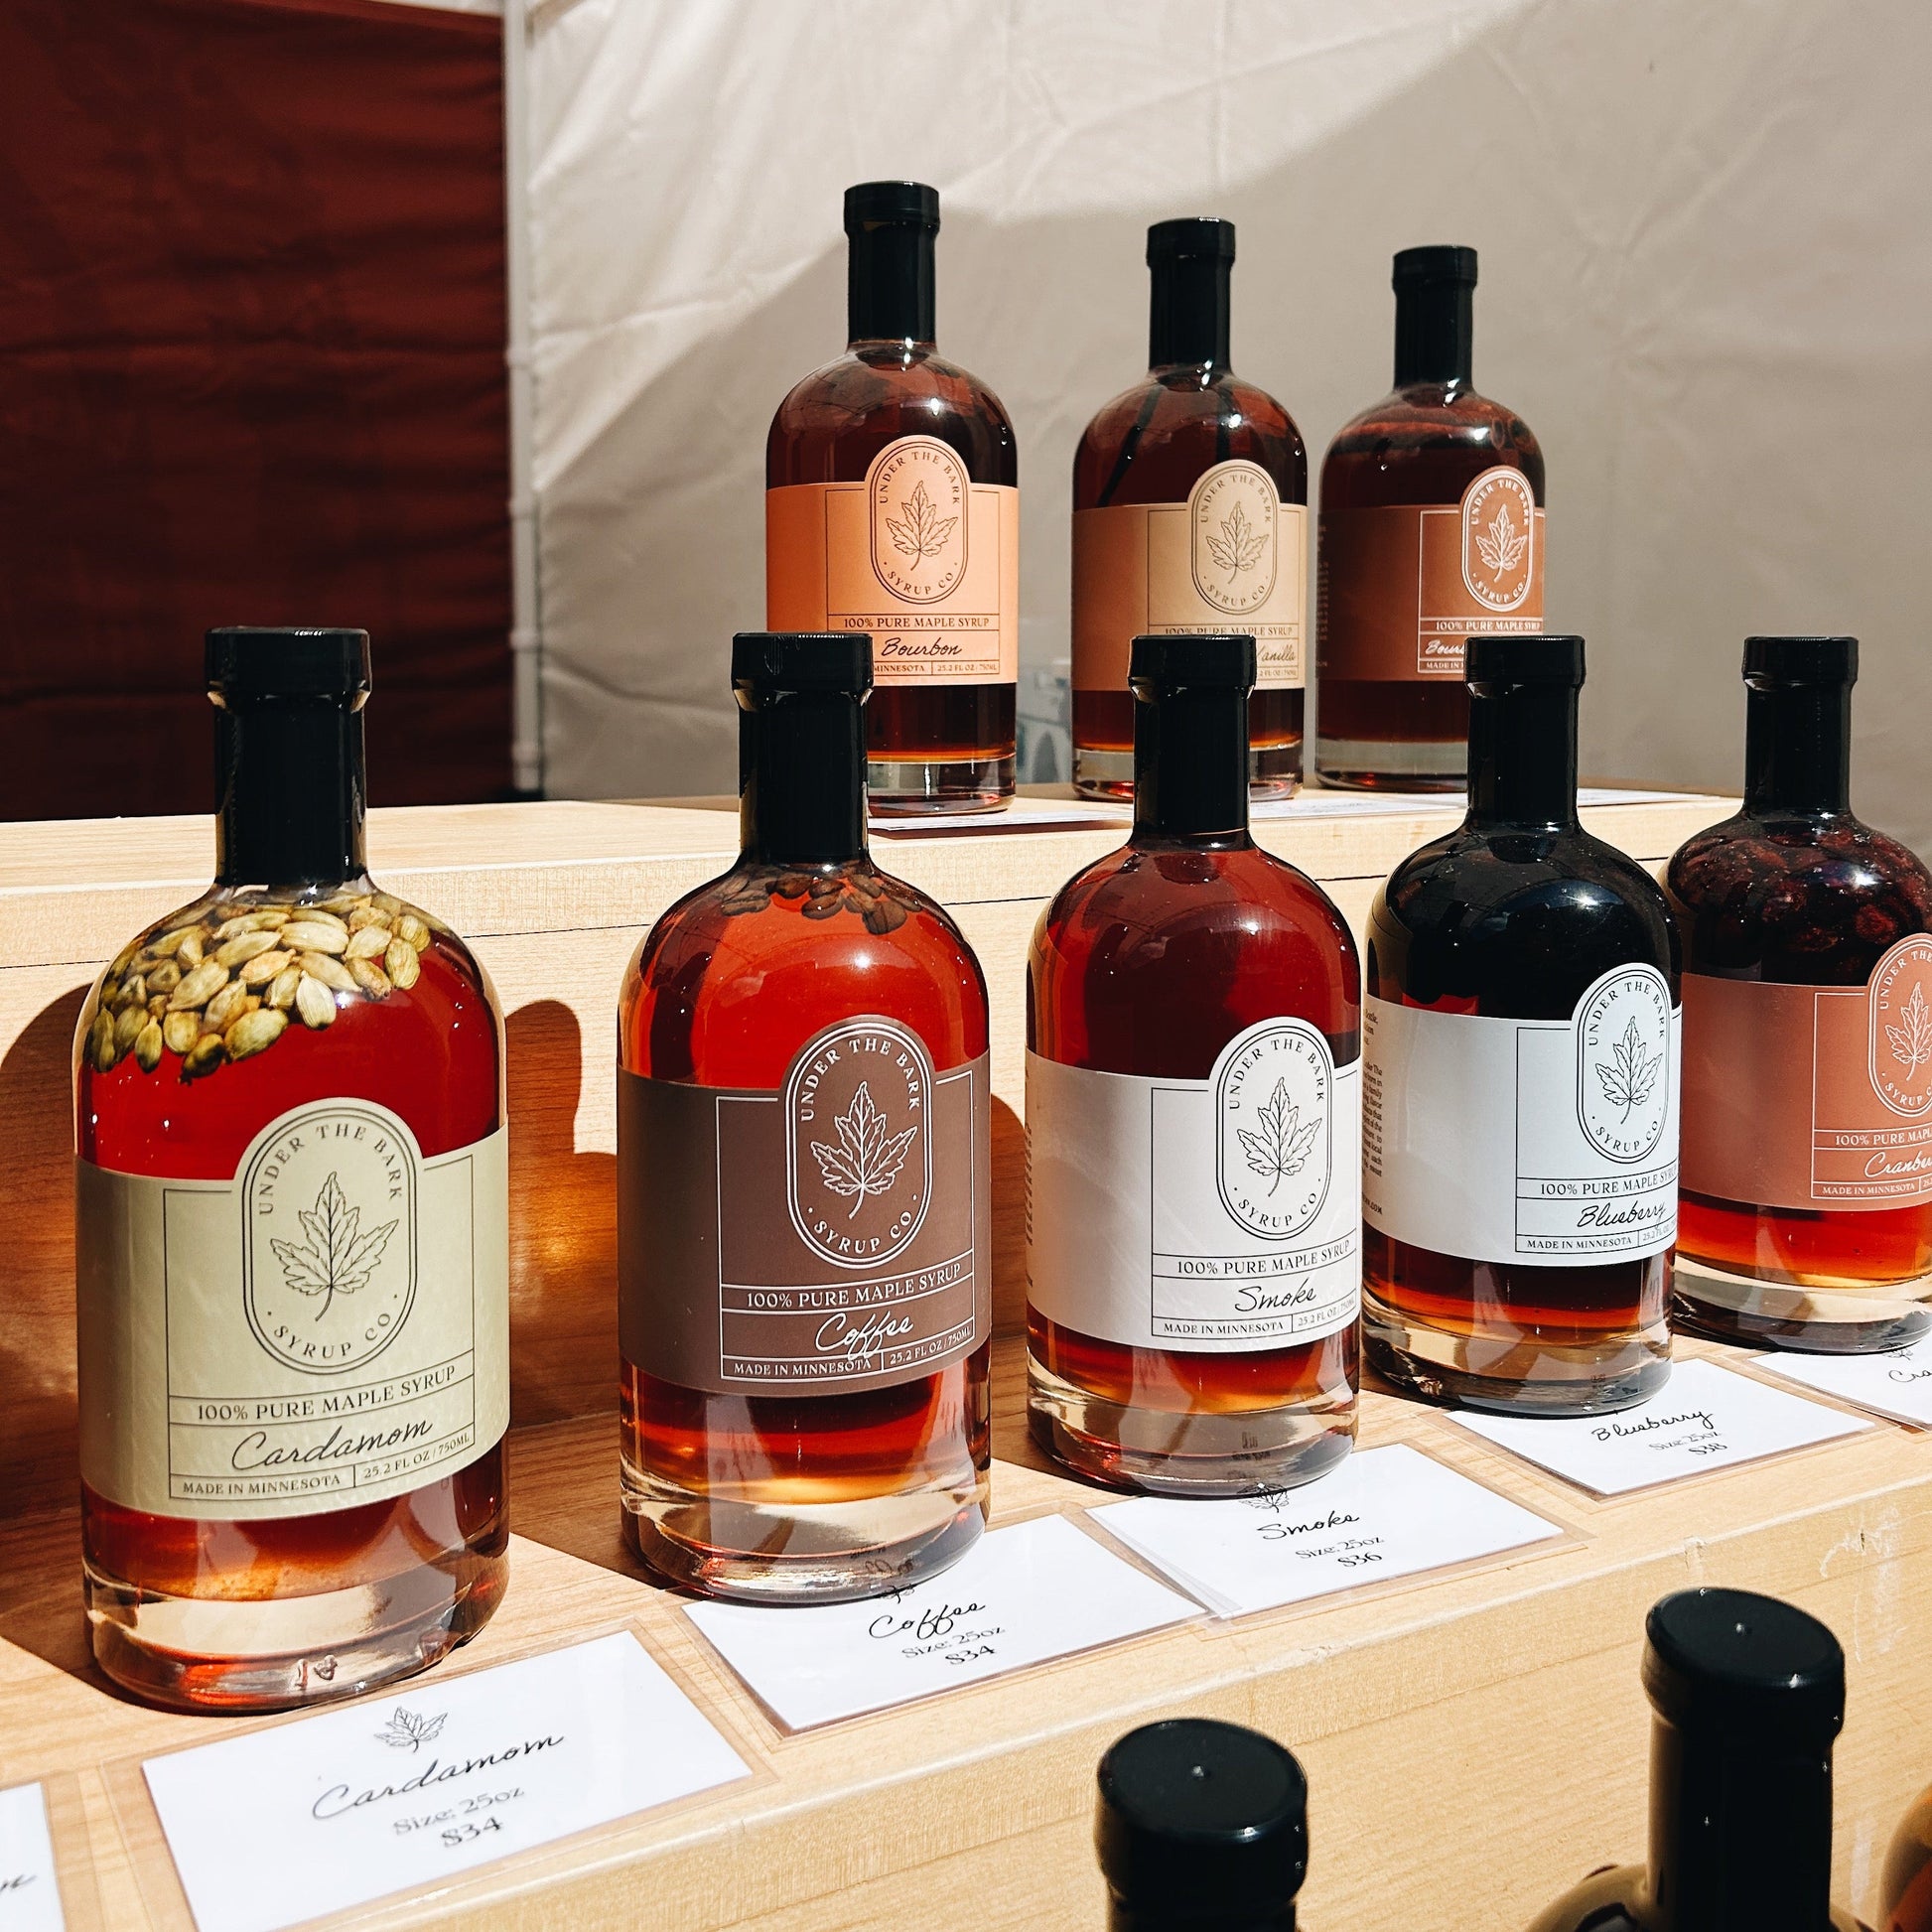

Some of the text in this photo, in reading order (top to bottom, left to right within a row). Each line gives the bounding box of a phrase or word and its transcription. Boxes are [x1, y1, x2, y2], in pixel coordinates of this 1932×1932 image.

[879, 451, 961, 504] UNDER THE BARK
[1200, 475, 1272, 523] UNDER THE BARK
[1470, 484, 1494, 526] UNDER
[1497, 479, 1519, 492] THE
[887, 570, 953, 596] SYRUP CO
[1206, 584, 1265, 607] SYRUP CO
[1475, 580, 1510, 604] SYRUP
[844, 618, 991, 628] 100% PURE MAPLE SYRUP
[1231, 626, 1265, 635] MAPLE
[1268, 625, 1293, 635] SYRUP
[1436, 621, 1463, 631] 100%
[1465, 621, 1491, 631] PURE
[1494, 621, 1523, 631] MAPLE
[881, 636, 963, 656] Bourbon
[1879, 949, 1932, 1011] UNDER THE
[1588, 981, 1666, 1046] UNDER THE BARK
[800, 1036, 920, 1122] UNDER THE BARK
[1228, 1038, 1325, 1111] UNDER THE BARK
[1884, 1082, 1924, 1106] SYRUP
[1596, 1120, 1658, 1152] SYRUP CO
[1835, 1134, 1869, 1146] 100%
[1872, 1132, 1905, 1146] PURE
[258, 1122, 403, 1215] UNDER THE BARK
[1541, 1183, 1578, 1195] 100%
[1583, 1181, 1618, 1195] PURE
[1622, 1173, 1657, 1191] MAPLE
[1821, 1186, 1852, 1195] MADE
[1854, 1186, 1864, 1195] IN
[1866, 1182, 1915, 1195] MINNESOTA
[1238, 1191, 1318, 1229] SYRUP CO
[1577, 1199, 1666, 1231] Blueberry
[814, 1210, 912, 1255] SYRUP CO
[1527, 1239, 1559, 1249] MADE
[1561, 1240, 1575, 1249] IN
[1577, 1236, 1632, 1249] MINNESOTA
[1176, 1239, 1350, 1275] 100% PURE MAPLE SYRUP
[747, 1263, 961, 1309] 100% PURE MAPLE SYRUP
[1234, 1277, 1317, 1312] Smoke
[274, 1312, 391, 1360] SYRUP CO
[814, 1311, 914, 1361] Coffee
[1164, 1322, 1198, 1334] MADE
[1200, 1323, 1213, 1334] IN
[1217, 1320, 1285, 1334] MINNESOTA
[1316, 1311, 1326, 1322] FL
[734, 1362, 771, 1376] MADE
[774, 1362, 788, 1376] IN
[791, 1358, 872, 1376] MINNESOTA
[890, 1349, 912, 1365] 25.2
[913, 1345, 927, 1360] FL
[928, 1338, 942, 1354] OZ
[947, 1326, 972, 1348] 750ML
[198, 1364, 457, 1421] 100% PURE MAPLE SYRUP
[1590, 1410, 1714, 1442] Blueberry
[1688, 1431, 1724, 1444] 25oz
[230, 1420, 433, 1470] Cardamom
[183, 1481, 224, 1495] MADE
[227, 1481, 244, 1495] IN
[248, 1473, 342, 1494] MINNESOTA
[363, 1462, 392, 1479] 25.2
[394, 1457, 411, 1473] FL
[413, 1449, 431, 1464] OZ
[438, 1432, 471, 1456] 750ML
[1257, 1509, 1360, 1540] Smoke
[1295, 1536, 1386, 1559] Size: 25oz
[1337, 1552, 1383, 1568] $36
[869, 1602, 986, 1640] Coffee
[901, 1626, 1007, 1659] Size: 25oz
[944, 1645, 996, 1665] $34
[312, 1735, 564, 1820] Cardamom
[393, 1787, 525, 1836] Size: 25oz
[441, 1816, 502, 1848] $34
